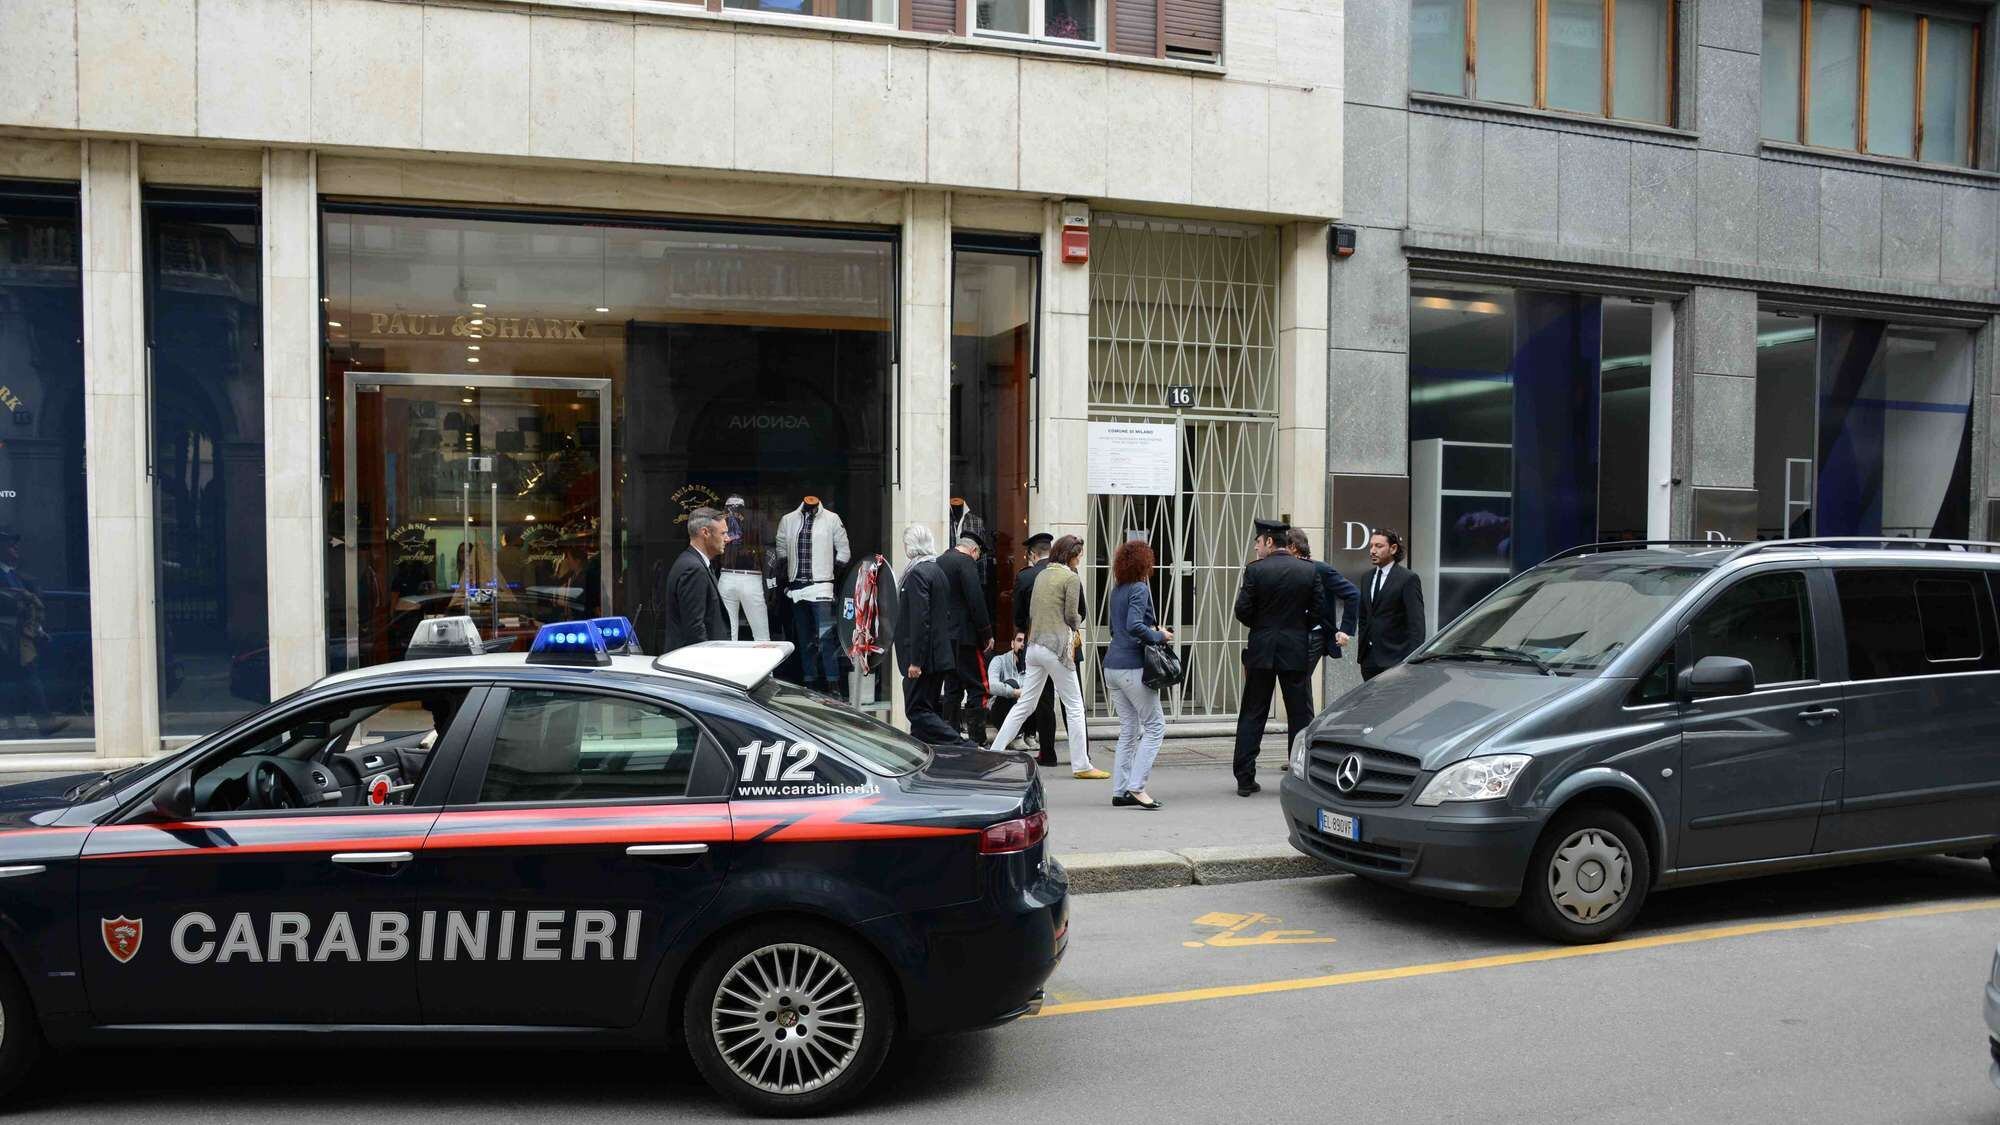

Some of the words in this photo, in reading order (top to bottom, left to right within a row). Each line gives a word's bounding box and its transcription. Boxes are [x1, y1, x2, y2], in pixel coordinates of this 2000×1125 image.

[370, 312, 445, 336] PAUL
[451, 315, 473, 337] &
[481, 317, 587, 340] SHARK
[1172, 388, 1190, 404] 16
[737, 740, 818, 782] 112
[738, 783, 881, 796] www.carabinieri.it
[170, 910, 642, 964] CARABINIERI
